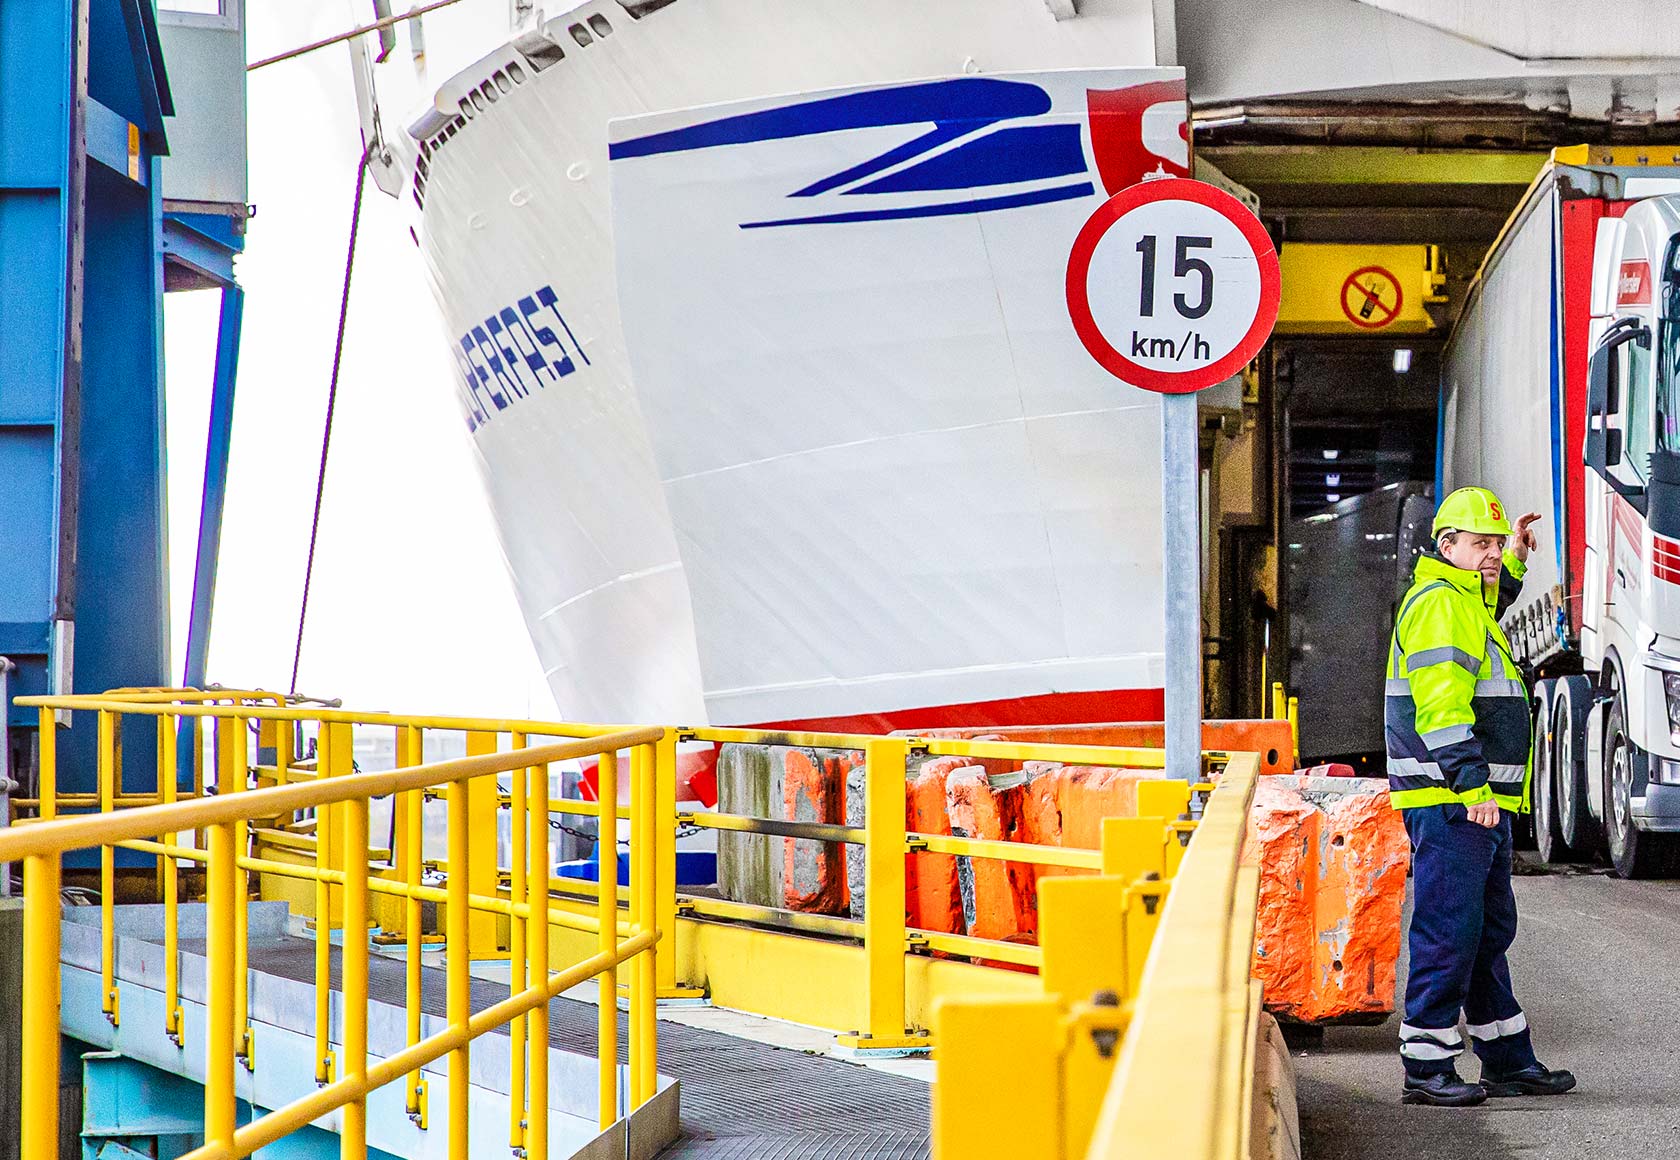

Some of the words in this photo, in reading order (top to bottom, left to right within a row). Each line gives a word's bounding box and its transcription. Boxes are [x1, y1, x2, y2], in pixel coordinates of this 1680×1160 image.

[1135, 235, 1214, 320] 15
[1131, 330, 1211, 362] km/h
[1490, 502, 1501, 521] S
